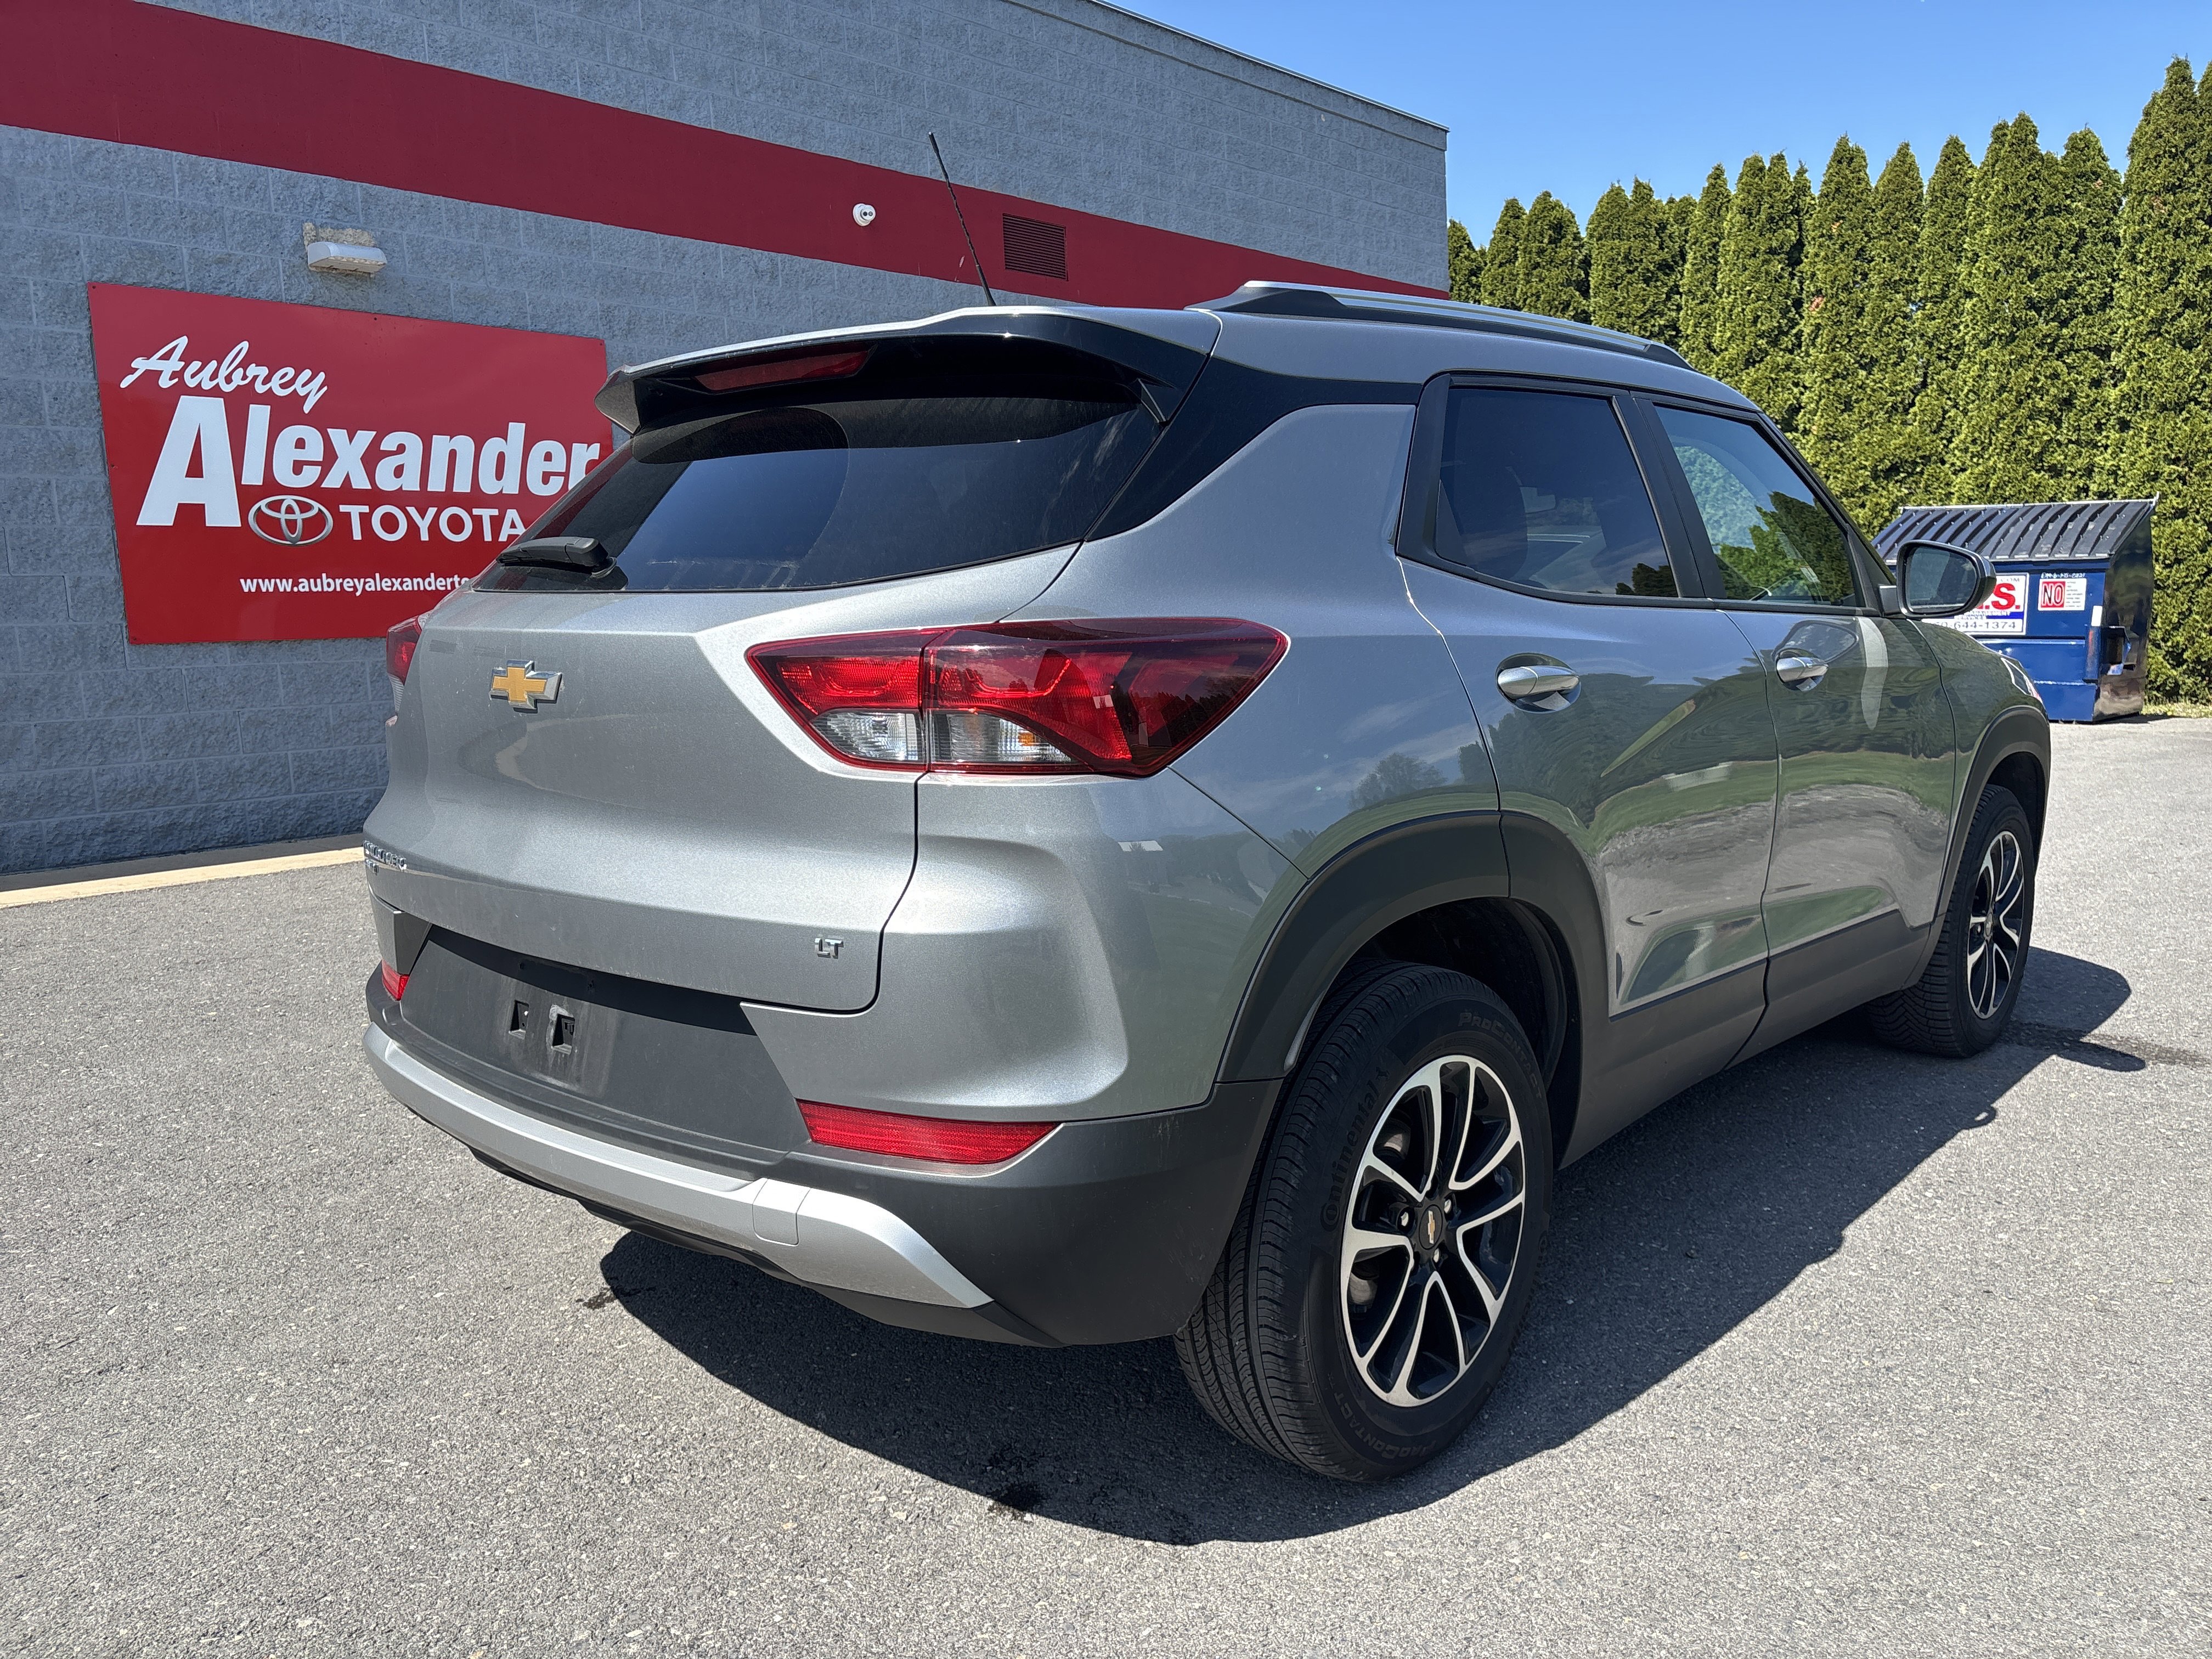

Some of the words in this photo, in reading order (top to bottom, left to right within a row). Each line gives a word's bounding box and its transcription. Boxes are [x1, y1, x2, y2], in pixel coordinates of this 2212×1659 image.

[120, 335, 328, 414] Aubrey
[136, 395, 601, 527] Alexander
[338, 505, 527, 542] TOYOTA
[2041, 583, 2064, 606] NO
[814, 938, 844, 959] LT
[1319, 1079, 1380, 1232] Continental
